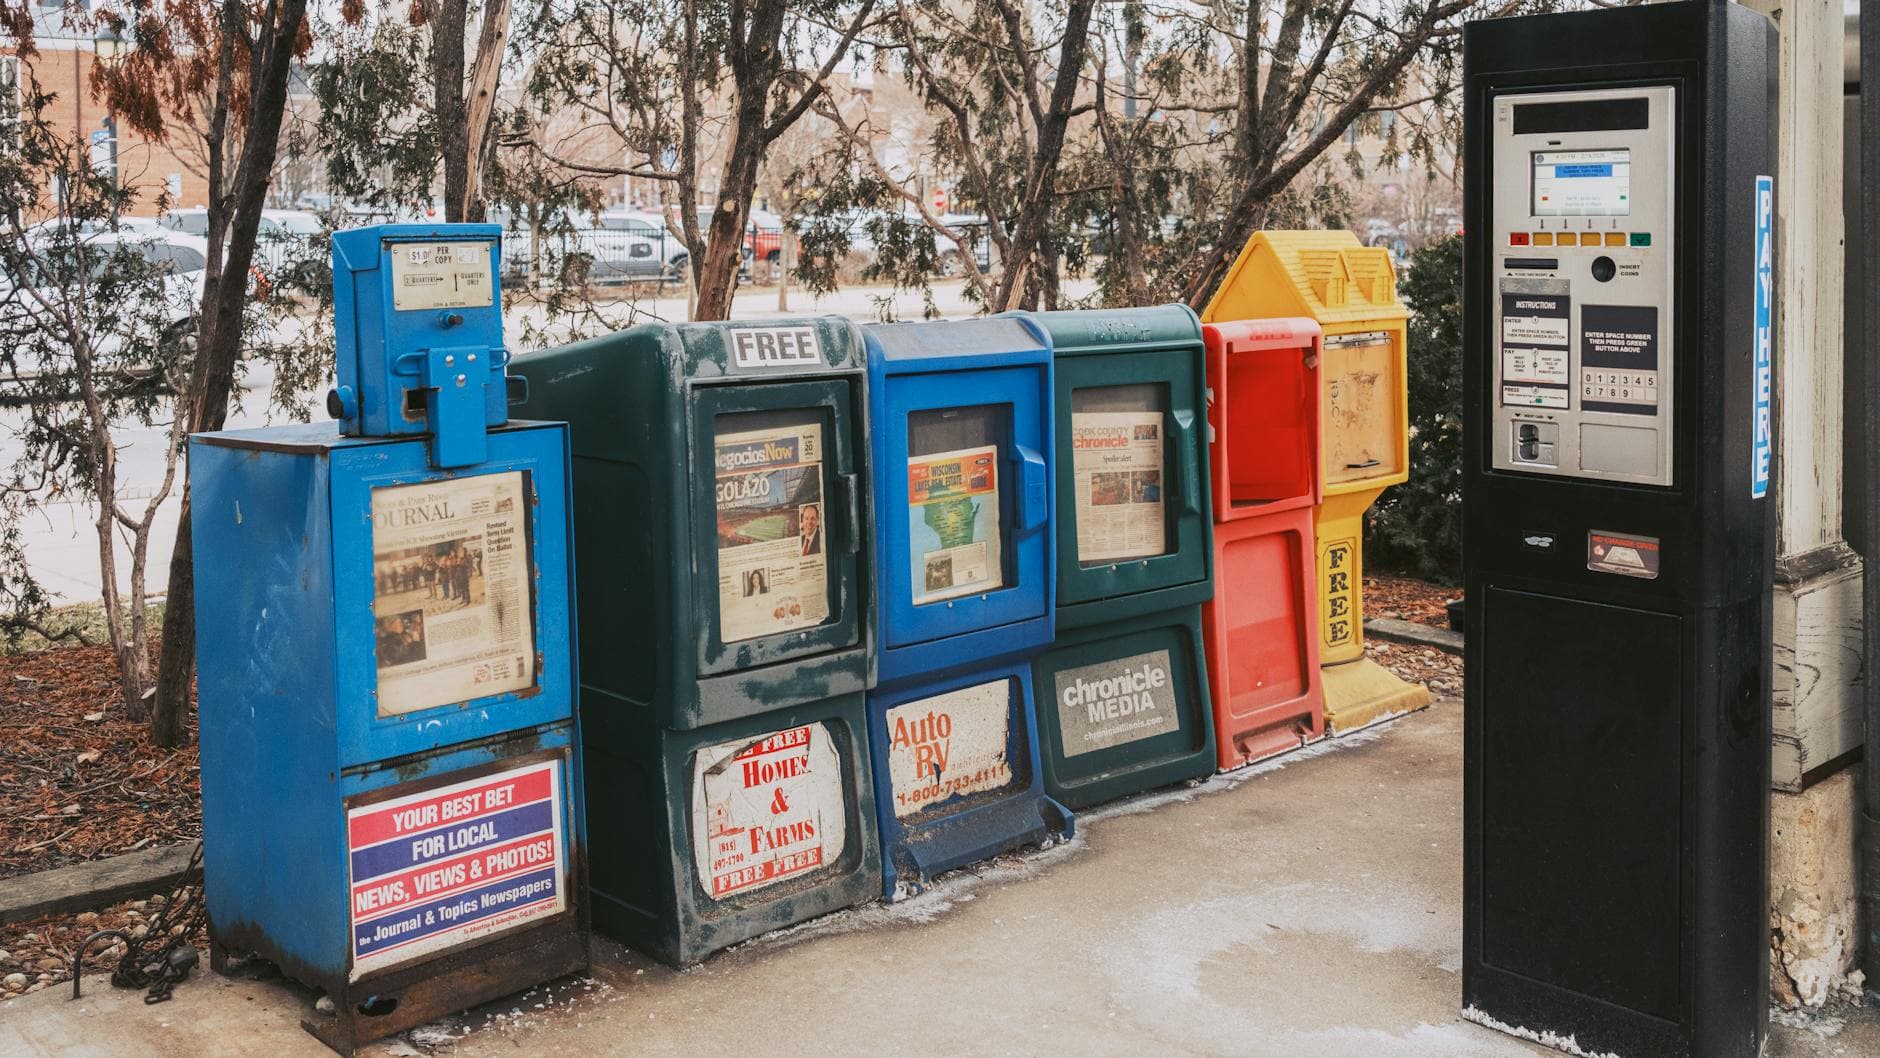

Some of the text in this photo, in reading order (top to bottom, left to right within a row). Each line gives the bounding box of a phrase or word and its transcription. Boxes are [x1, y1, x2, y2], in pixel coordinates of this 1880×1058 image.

[1516, 301, 1556, 310] INSTRUCTIONS
[736, 332, 815, 361] FREE
[1756, 190, 1770, 482] PAY HERE
[1073, 433, 1128, 448] chronicle
[931, 463, 961, 477] WISCONSIN
[946, 474, 962, 488] ESTATE
[716, 477, 770, 502] GOLAZO
[374, 502, 454, 528] OURNAL
[487, 537, 511, 546] Question
[1329, 547, 1349, 643] FREE
[1063, 664, 1165, 707] chronicle
[1087, 691, 1155, 723] MEDIA
[762, 728, 806, 751] FREE
[893, 711, 951, 751] Auto
[742, 754, 811, 788] HOMES
[916, 739, 950, 779] RV
[771, 787, 789, 815] &
[899, 764, 1004, 806] 1-800-733-4111
[393, 784, 515, 832] YOUR BEST BET
[412, 822, 498, 861] FOR LOCAL
[719, 840, 736, 854] (815)
[749, 819, 815, 854] FARMS
[356, 840, 552, 914] NEWS, VIEWS & PHOTOS!
[714, 853, 744, 871] 497-1700
[717, 850, 818, 891] FREE FREE
[359, 878, 552, 946] the Journal & Topics Newspapers
